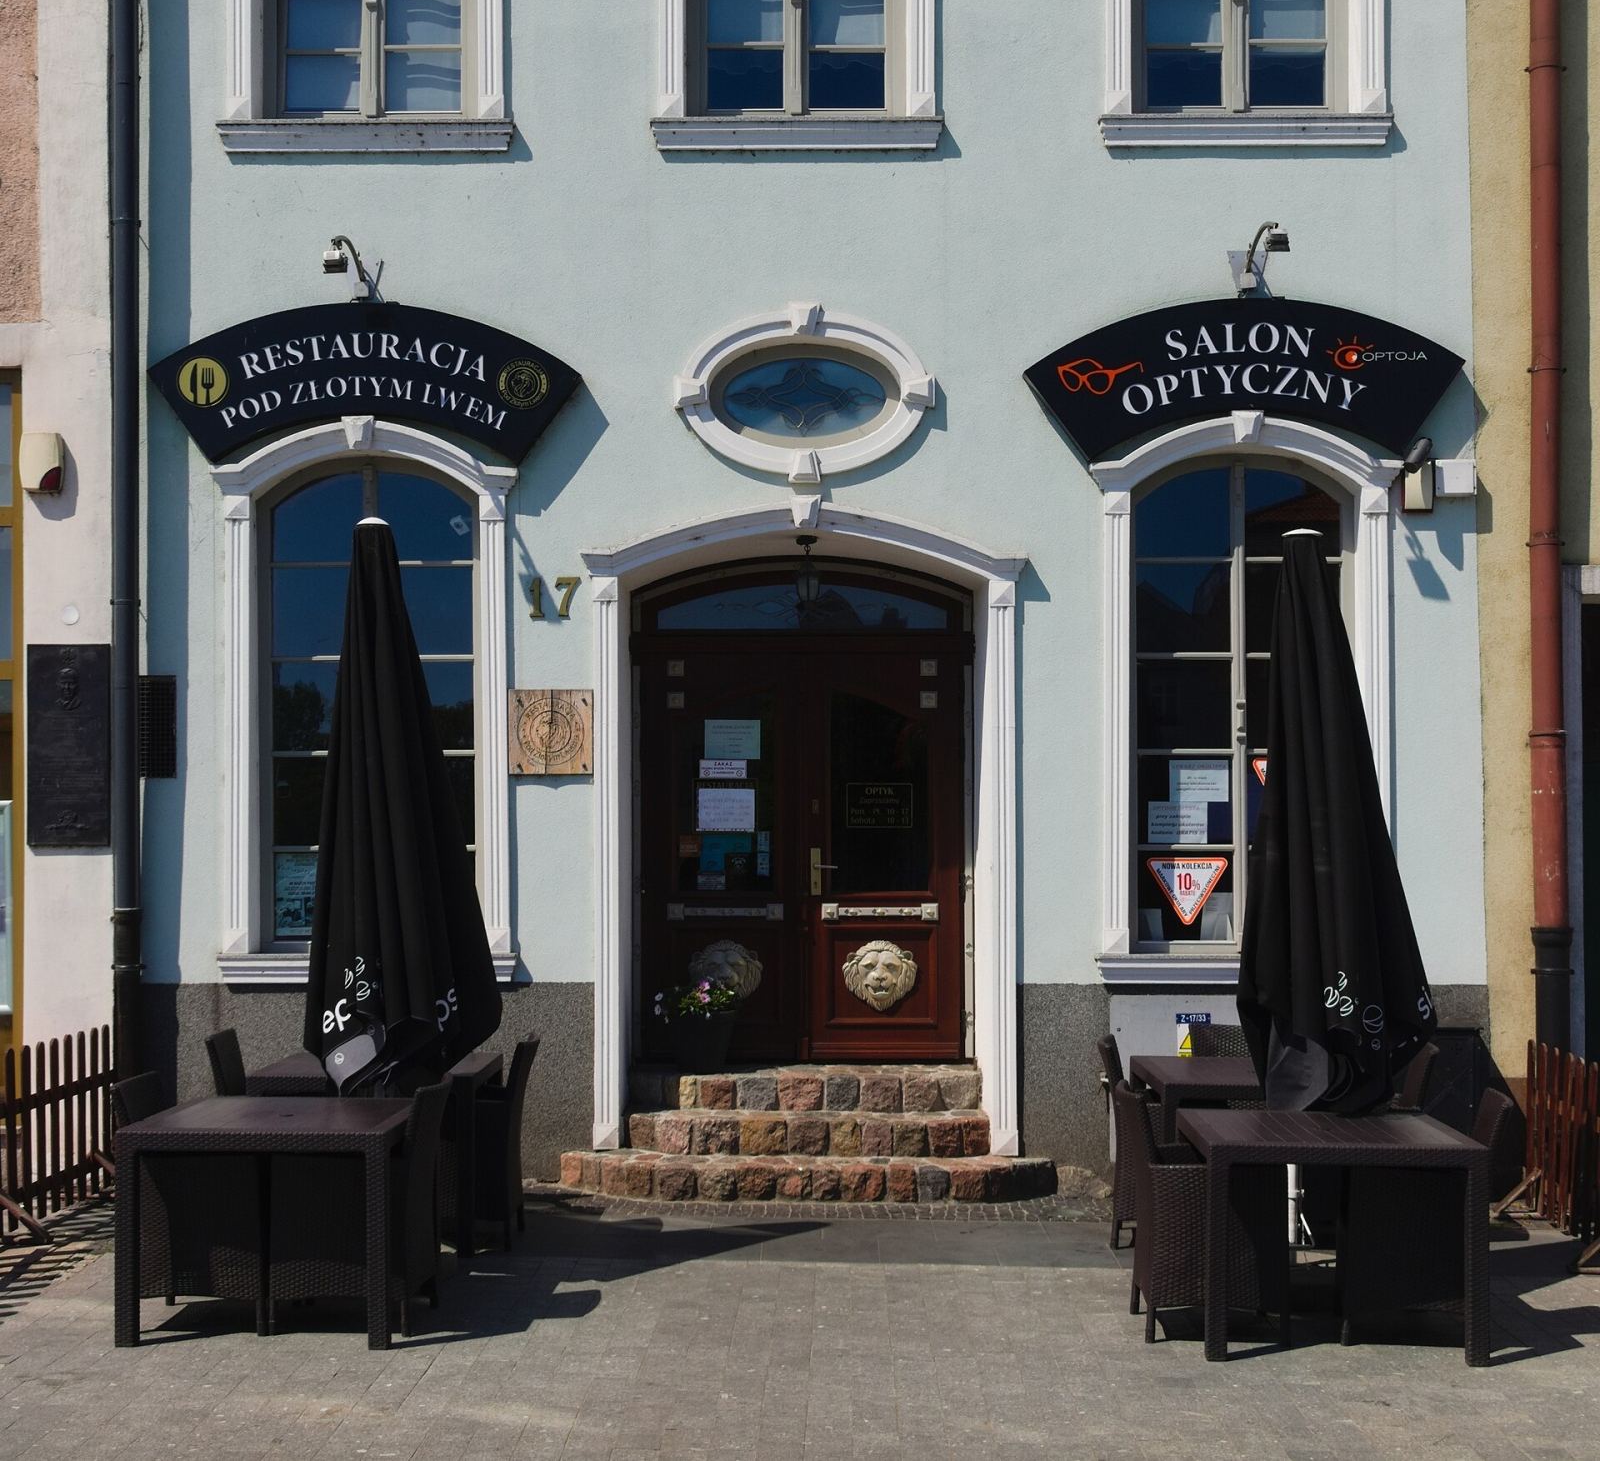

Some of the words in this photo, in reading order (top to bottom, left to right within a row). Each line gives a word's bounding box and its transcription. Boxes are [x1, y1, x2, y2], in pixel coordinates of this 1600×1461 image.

[238, 332, 487, 382] RESTAURACJA
[1165, 322, 1315, 361] SALON
[1362, 350, 1428, 362] OPTOJA
[220, 387, 282, 429] POD
[289, 374, 412, 405] ZŁOTYM
[422, 384, 508, 431] LWEM
[1122, 363, 1367, 415] OPTYCZNY
[529, 576, 582, 619] 17
[865, 786, 895, 795] OPTYK
[1161, 862, 1180, 870] NOWA
[1182, 862, 1213, 870] KOLEKCJA
[1177, 873, 1201, 891] 10%
